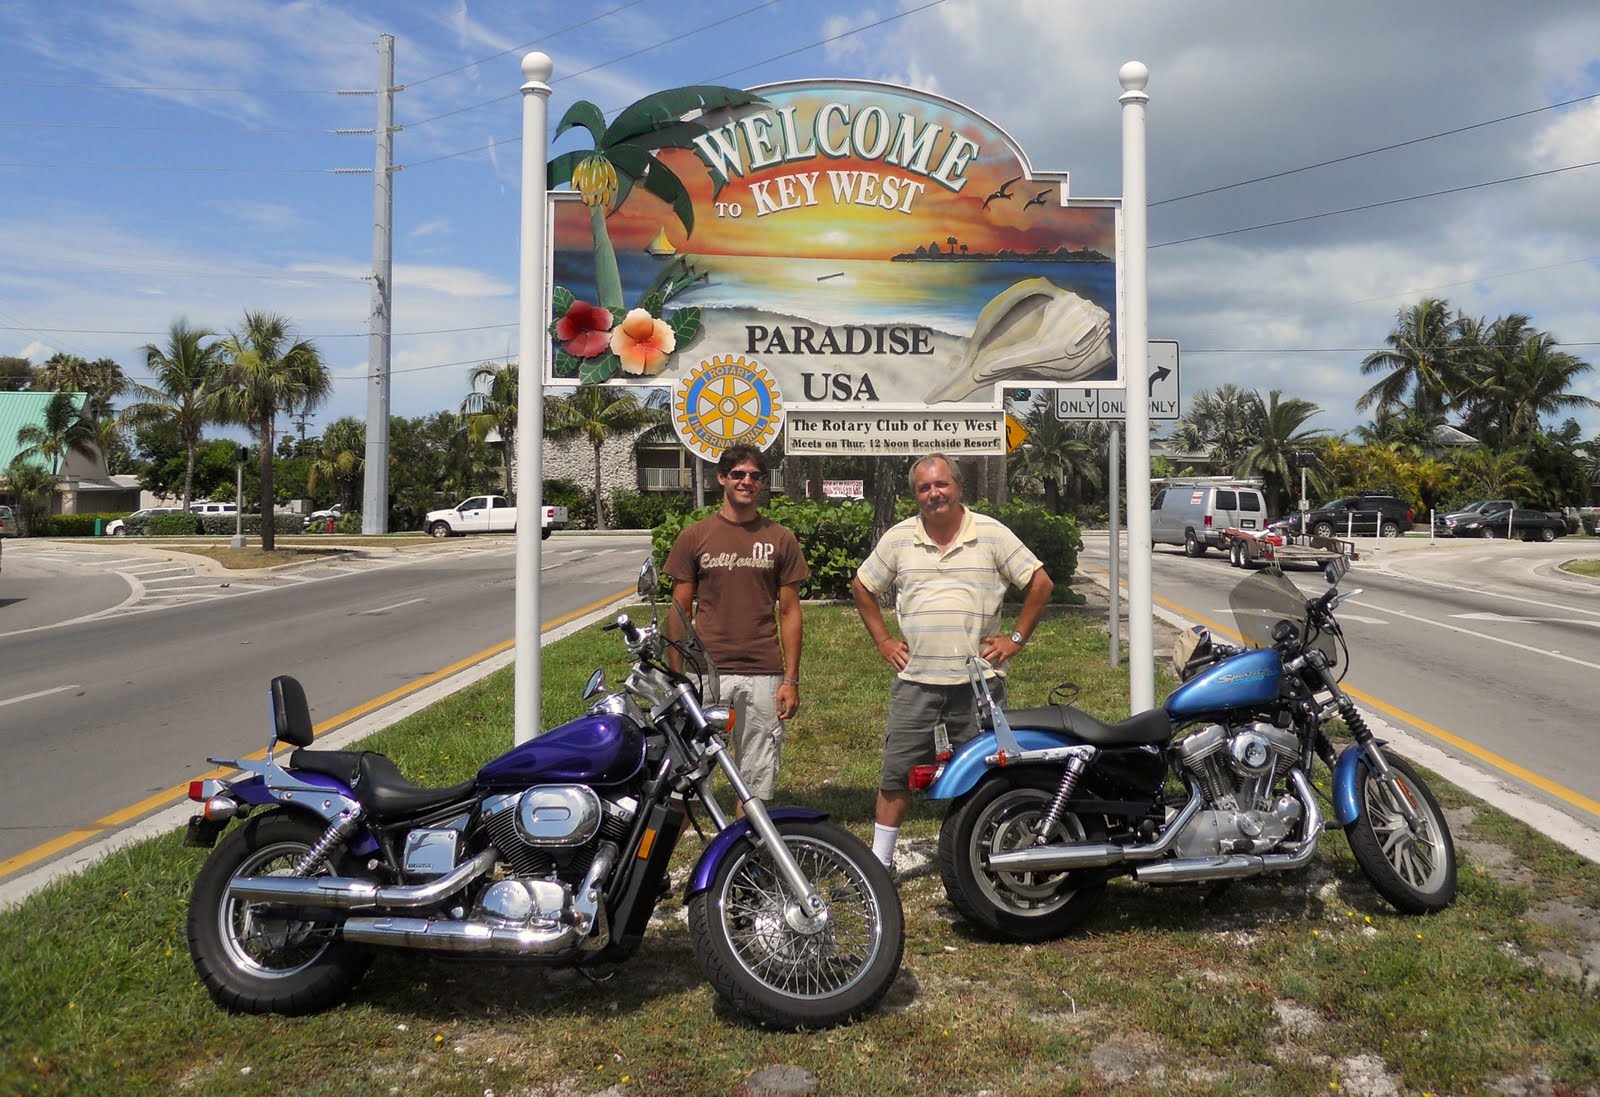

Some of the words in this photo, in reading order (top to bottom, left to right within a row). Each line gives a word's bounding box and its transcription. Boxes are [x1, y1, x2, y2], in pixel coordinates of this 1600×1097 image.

[692, 102, 980, 192] WELCOME
[715, 202, 742, 218] TO
[749, 171, 819, 217] KEY
[827, 170, 924, 214] WEST
[745, 325, 935, 355] PARADISE
[709, 366, 752, 378] ROTARY
[801, 373, 879, 402] USA
[1060, 401, 1095, 413] ONLY
[1102, 401, 1126, 413] ONL
[1149, 401, 1177, 413] NLY
[691, 418, 766, 447] INTERNATIONAL
[793, 419, 818, 431] The
[822, 419, 872, 434] Rotary
[876, 419, 908, 431] Club
[913, 419, 929, 431] of
[932, 419, 960, 434] Key
[964, 419, 998, 431] West
[792, 439, 822, 448] Meets
[825, 440, 838, 448] on
[840, 439, 865, 448] Thur.
[869, 438, 881, 448] 12
[883, 439, 909, 448] Noon
[912, 438, 961, 448] Beachside
[964, 438, 999, 448] Resort
[752, 541, 775, 560] OP
